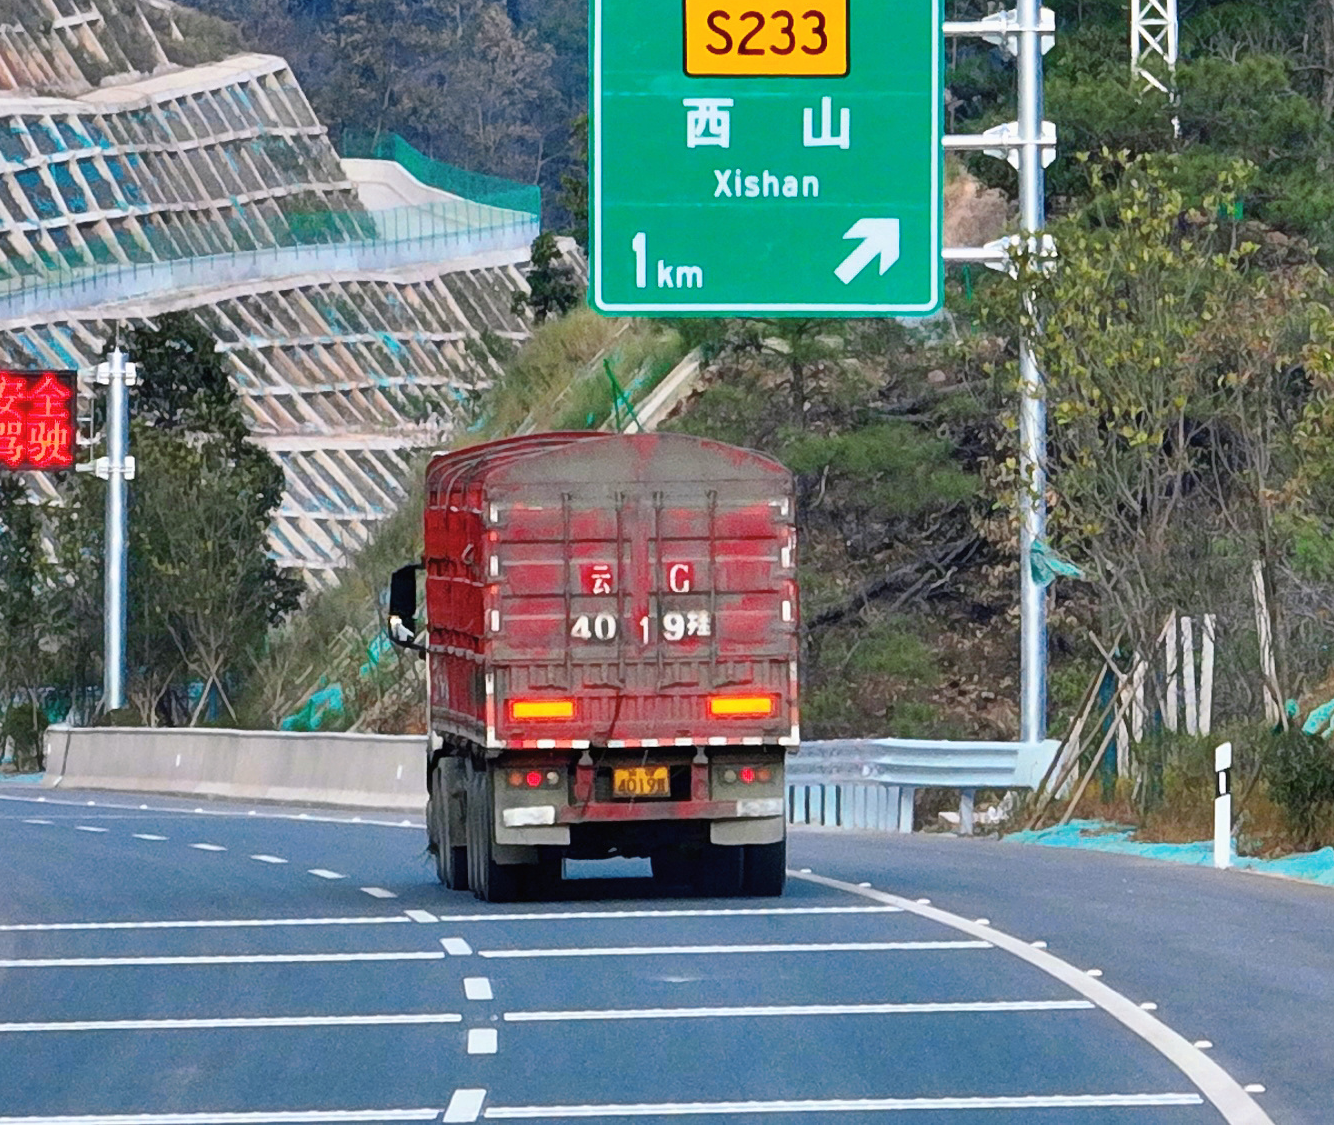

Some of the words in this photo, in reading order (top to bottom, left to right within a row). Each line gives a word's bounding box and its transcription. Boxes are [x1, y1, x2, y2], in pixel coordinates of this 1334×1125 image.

[706, 10, 828, 56] S233
[683, 97, 851, 150] 西山
[714, 170, 819, 198] Xishan
